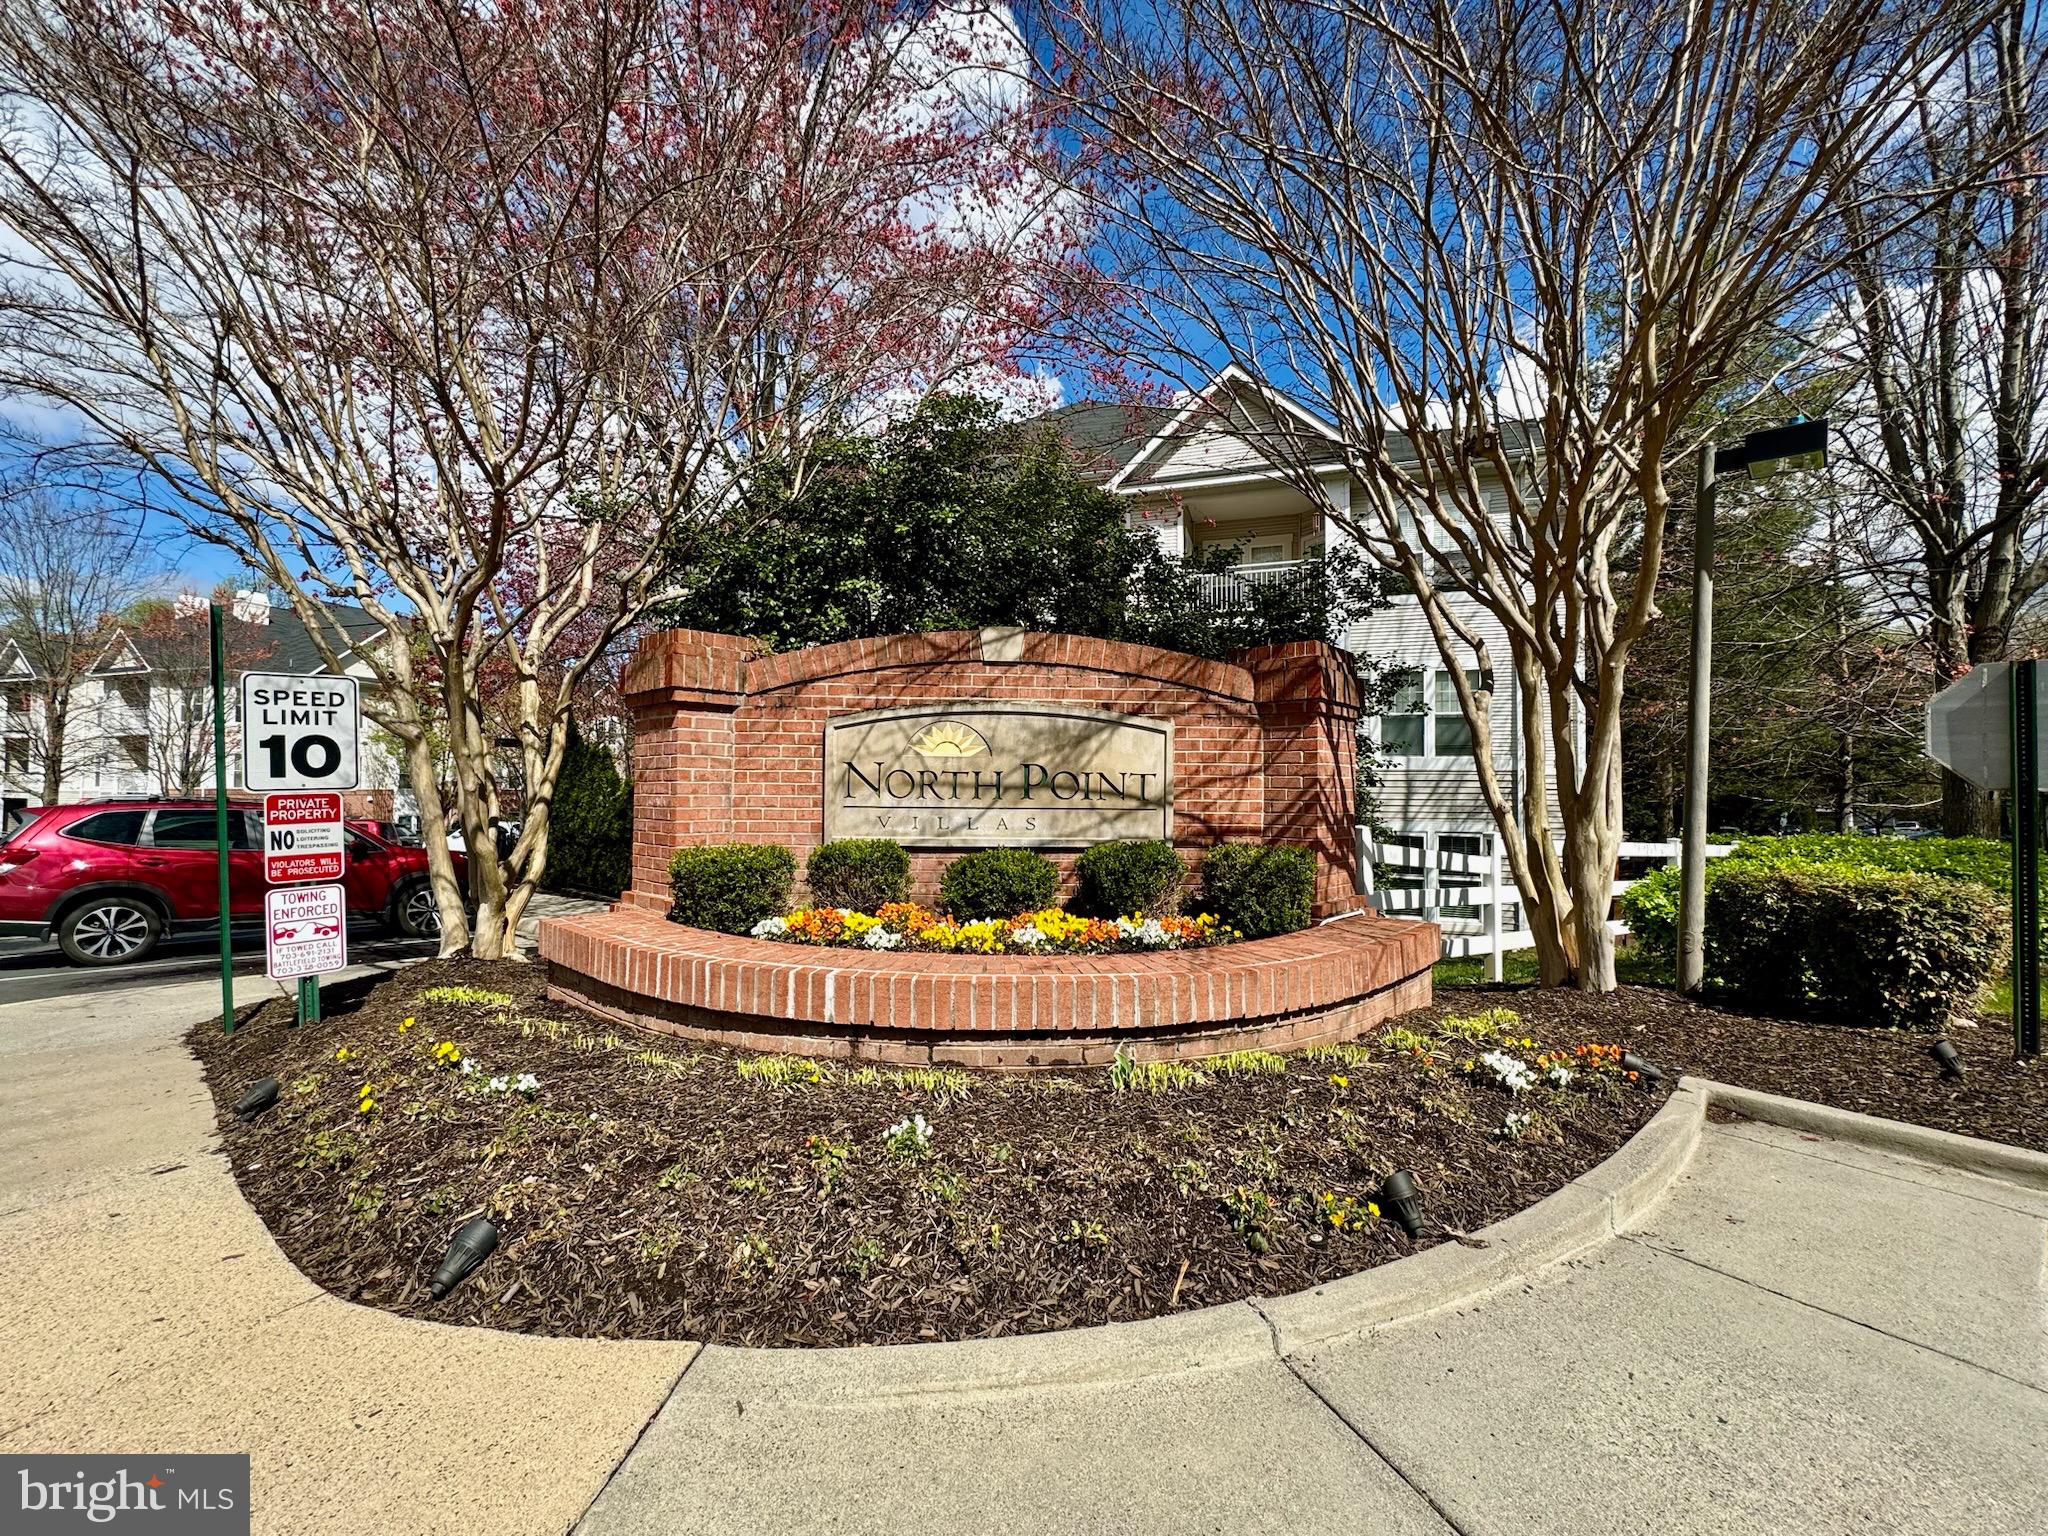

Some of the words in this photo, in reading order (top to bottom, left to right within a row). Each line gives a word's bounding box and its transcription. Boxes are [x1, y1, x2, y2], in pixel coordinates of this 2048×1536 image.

[254, 689, 345, 707] SPEED
[263, 709, 337, 726] LIMIT
[259, 734, 341, 778] 10
[278, 797, 330, 810] PRIVATE
[270, 808, 337, 821] PROPERTY
[877, 815, 1037, 831] VILLAS
[270, 830, 295, 851] NO
[271, 859, 316, 869] VIOLATORS
[320, 858, 339, 866] WILL
[271, 869, 283, 877] BE
[287, 865, 339, 876] PROSECUTED
[281, 890, 327, 905] TOWING
[273, 903, 338, 920] ENFORCED
[287, 944, 314, 953] TOWED
[316, 941, 337, 949] CALL
[273, 957, 316, 969] BATTLEFIELD
[317, 953, 342, 962] TOWING
